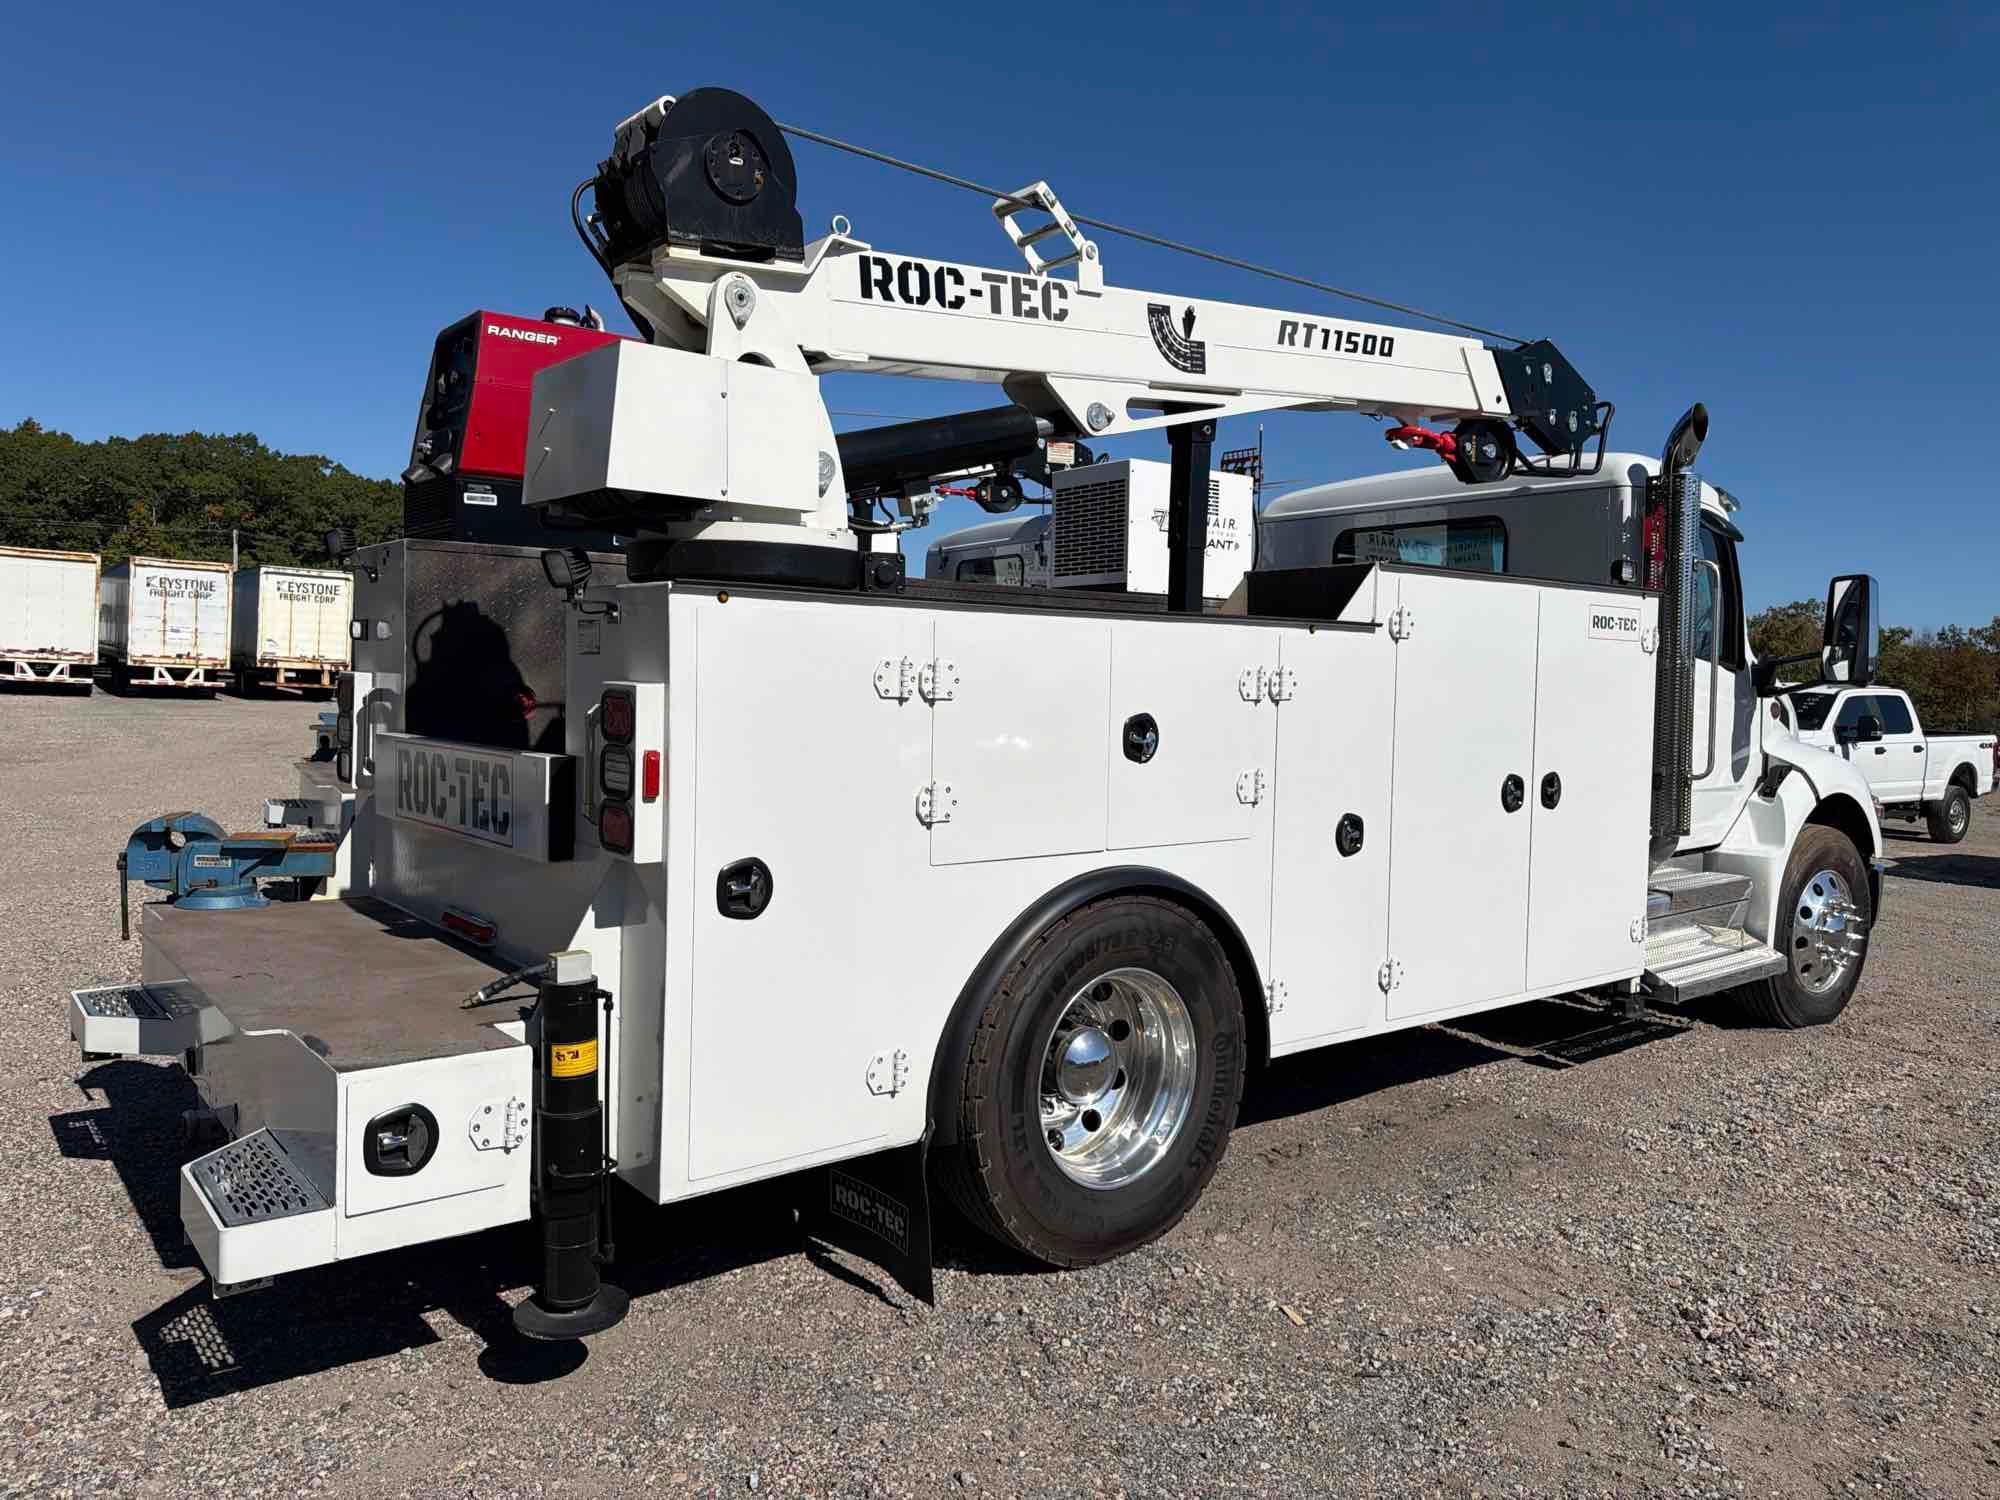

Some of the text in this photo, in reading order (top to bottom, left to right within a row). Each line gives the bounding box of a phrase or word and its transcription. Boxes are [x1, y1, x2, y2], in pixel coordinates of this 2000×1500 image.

[859, 254, 1069, 322] ROC-TEC
[487, 324, 558, 346] RANGER
[1277, 319, 1395, 358] RT11500
[149, 588, 185, 599] FREIGHT
[280, 592, 311, 602] FREIGHT
[1592, 614, 1638, 632] ROC-TEC
[398, 749, 510, 836] ROC-TEC
[835, 1182, 905, 1238] ROC-TEC
